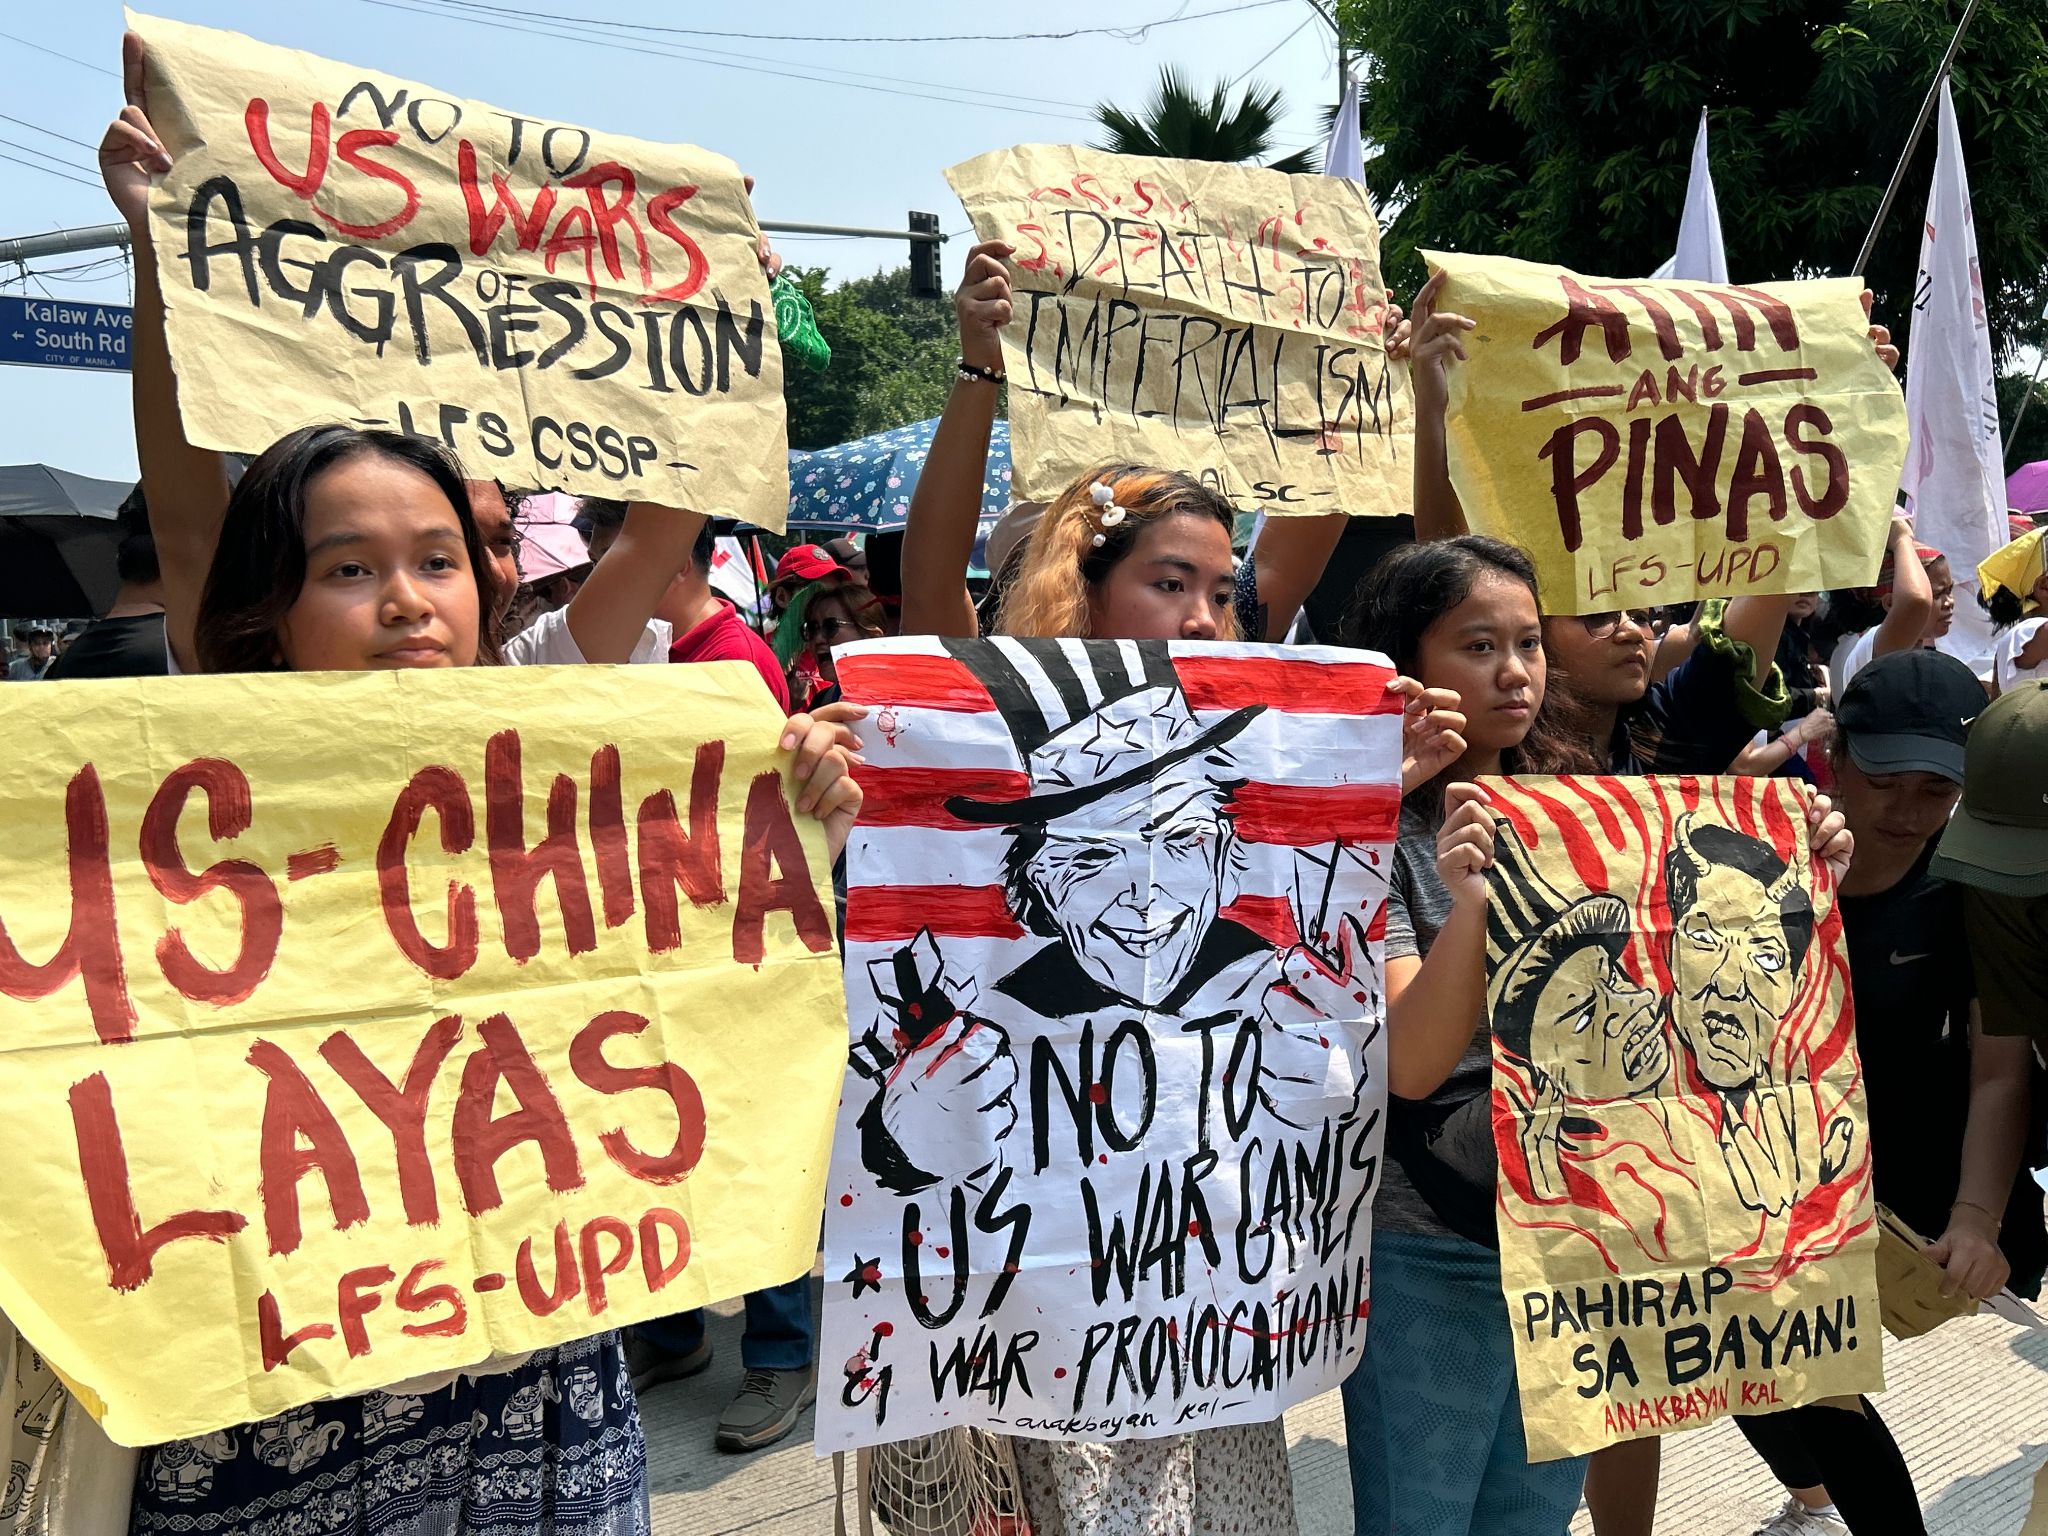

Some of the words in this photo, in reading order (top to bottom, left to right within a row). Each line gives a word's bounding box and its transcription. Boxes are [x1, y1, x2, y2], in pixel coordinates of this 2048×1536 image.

[336, 81, 462, 144] NO
[491, 111, 590, 178] TO
[245, 97, 422, 239] US
[458, 139, 711, 307] WARS
[24, 301, 88, 325] Kalaw
[93, 308, 133, 329] Ave
[178, 175, 765, 397] AGGRESSION
[476, 269, 524, 302] OF
[1052, 208, 1275, 321] DEATH
[1290, 258, 1346, 330] TO
[1532, 274, 1800, 367] ATIN
[35, 327, 94, 351] South
[99, 333, 126, 353] Rd
[45, 353, 65, 363] CITY
[69, 355, 80, 364] OF
[85, 357, 116, 367] MANILA
[1015, 290, 1397, 468] IMPERIALISM
[1625, 363, 1728, 412] ANG
[1538, 403, 1850, 553] PINAS
[1588, 542, 1782, 600] LFS-UPD
[1029, 1018, 1157, 1176] NO
[1181, 1009, 1264, 1152] TO
[67, 1010, 707, 1294] LAYAS
[902, 1166, 1032, 1329] US
[1080, 1149, 1222, 1306] WAR
[1235, 1107, 1381, 1285] GAMES
[258, 1207, 691, 1372] LFS-UPD
[929, 1324, 1040, 1412] WAR
[1072, 1256, 1367, 1414] PROVOCATION!
[1522, 1266, 1734, 1342] PAHIRAP
[1572, 1341, 1639, 1399] SA
[1664, 1295, 1858, 1386] BAYAN!
[1741, 1379, 1784, 1407] KAL
